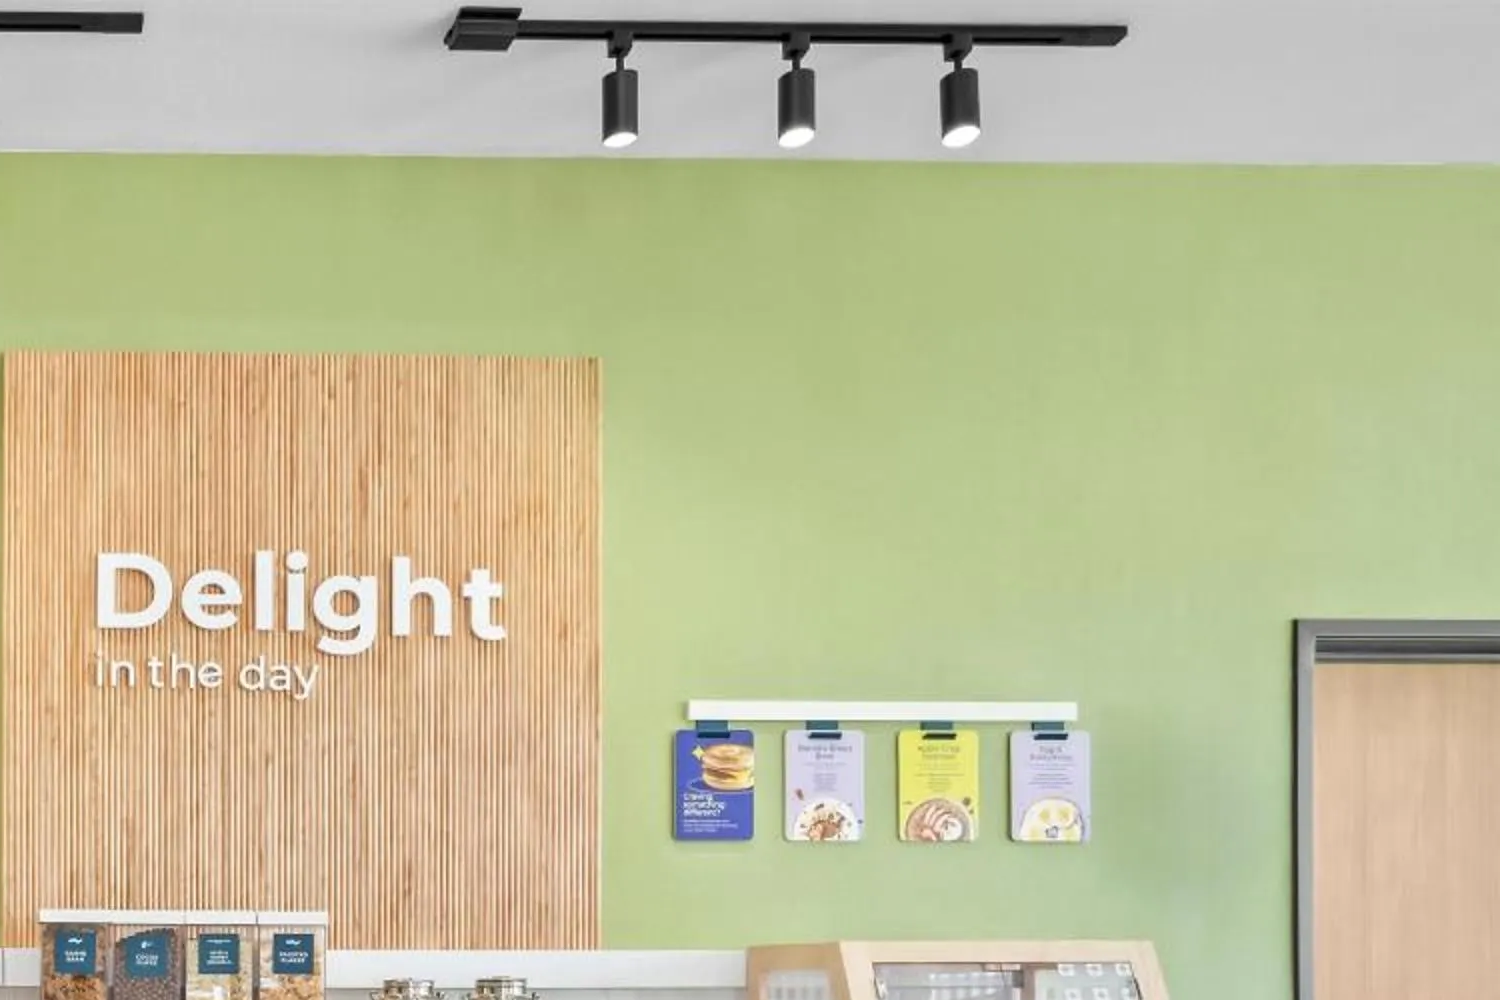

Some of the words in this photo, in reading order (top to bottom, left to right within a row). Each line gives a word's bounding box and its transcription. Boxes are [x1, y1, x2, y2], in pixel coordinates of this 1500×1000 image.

[96, 549, 508, 656] Delight
[94, 651, 136, 688] in
[148, 651, 224, 690] the
[238, 655, 321, 701] day
